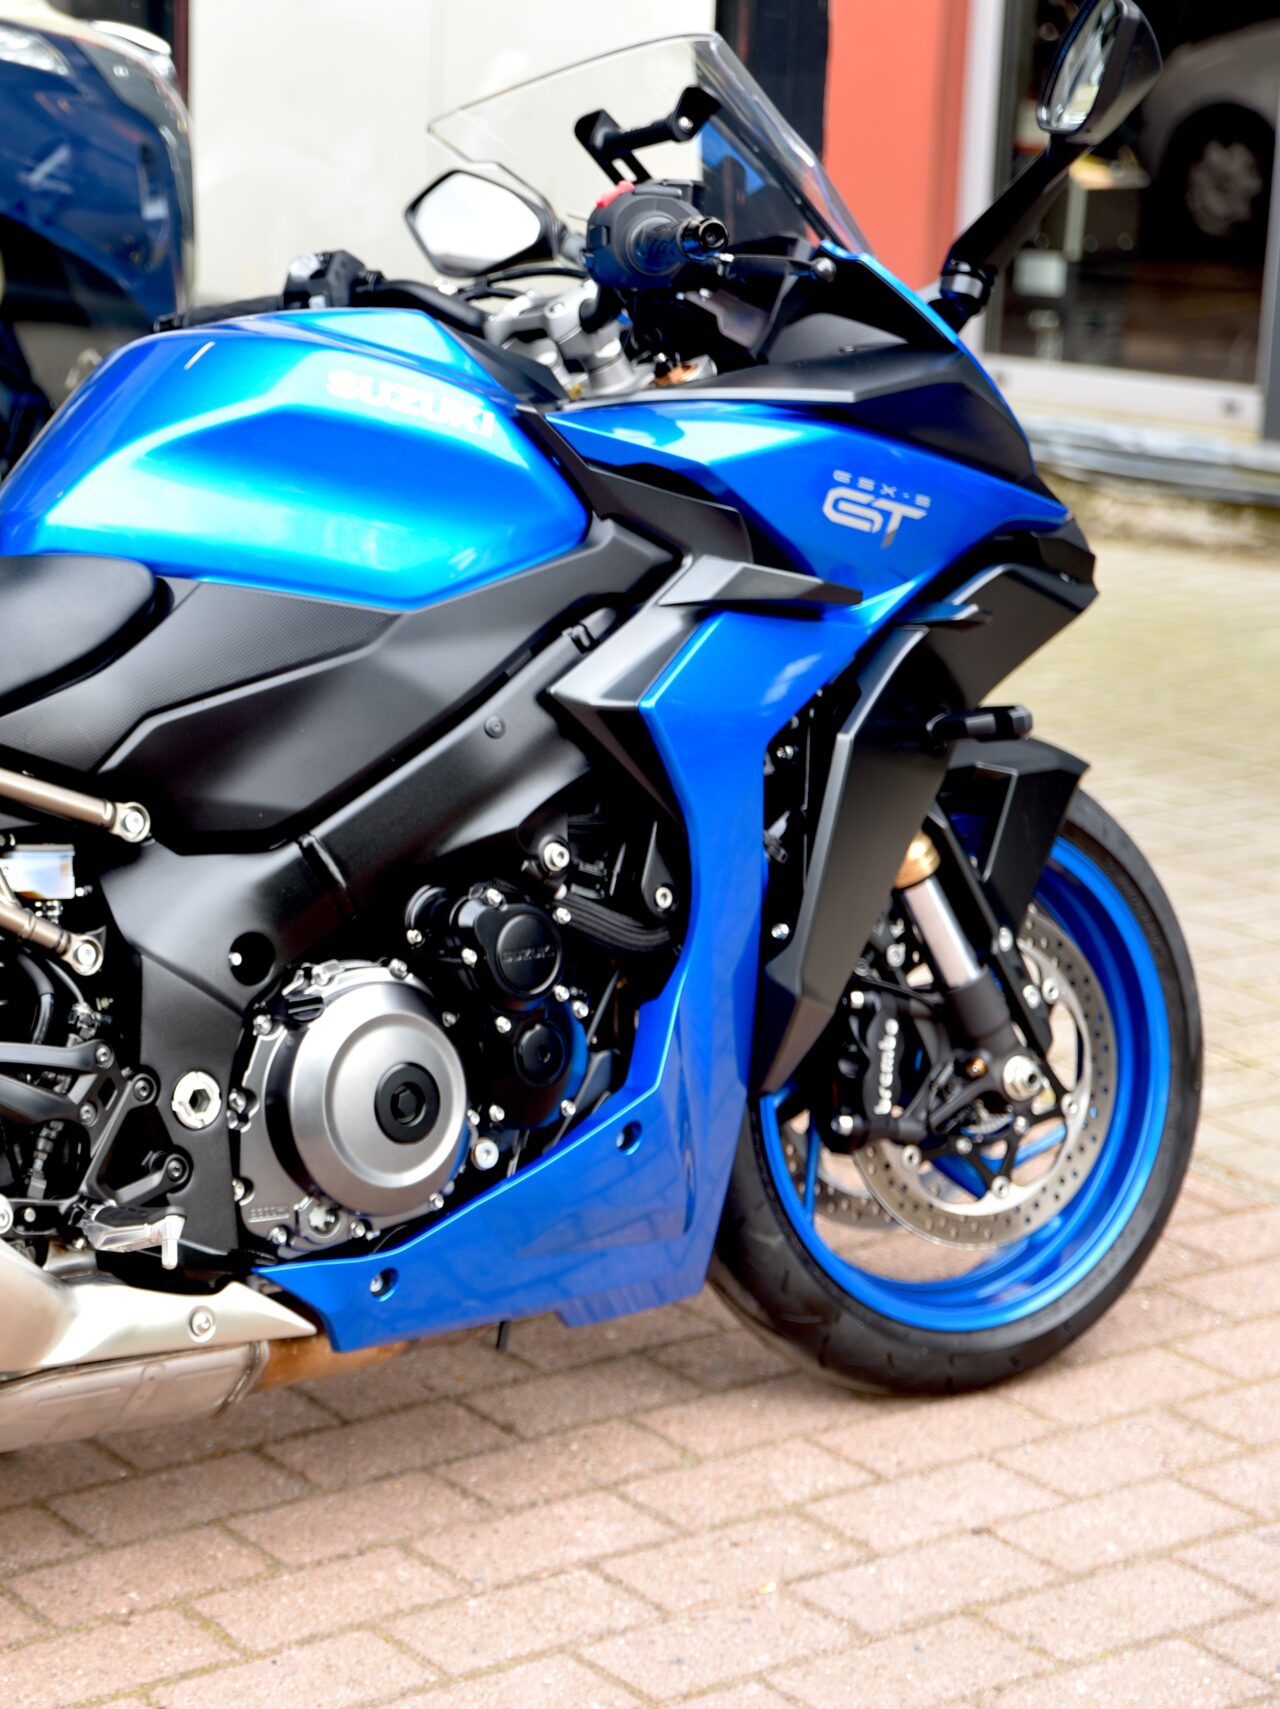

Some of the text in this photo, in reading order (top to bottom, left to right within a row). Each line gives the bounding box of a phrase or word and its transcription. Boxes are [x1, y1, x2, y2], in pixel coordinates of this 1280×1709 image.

[326, 368, 495, 439] SUZUKI
[822, 486, 928, 550] GT
[873, 1018, 899, 1115] brembo
